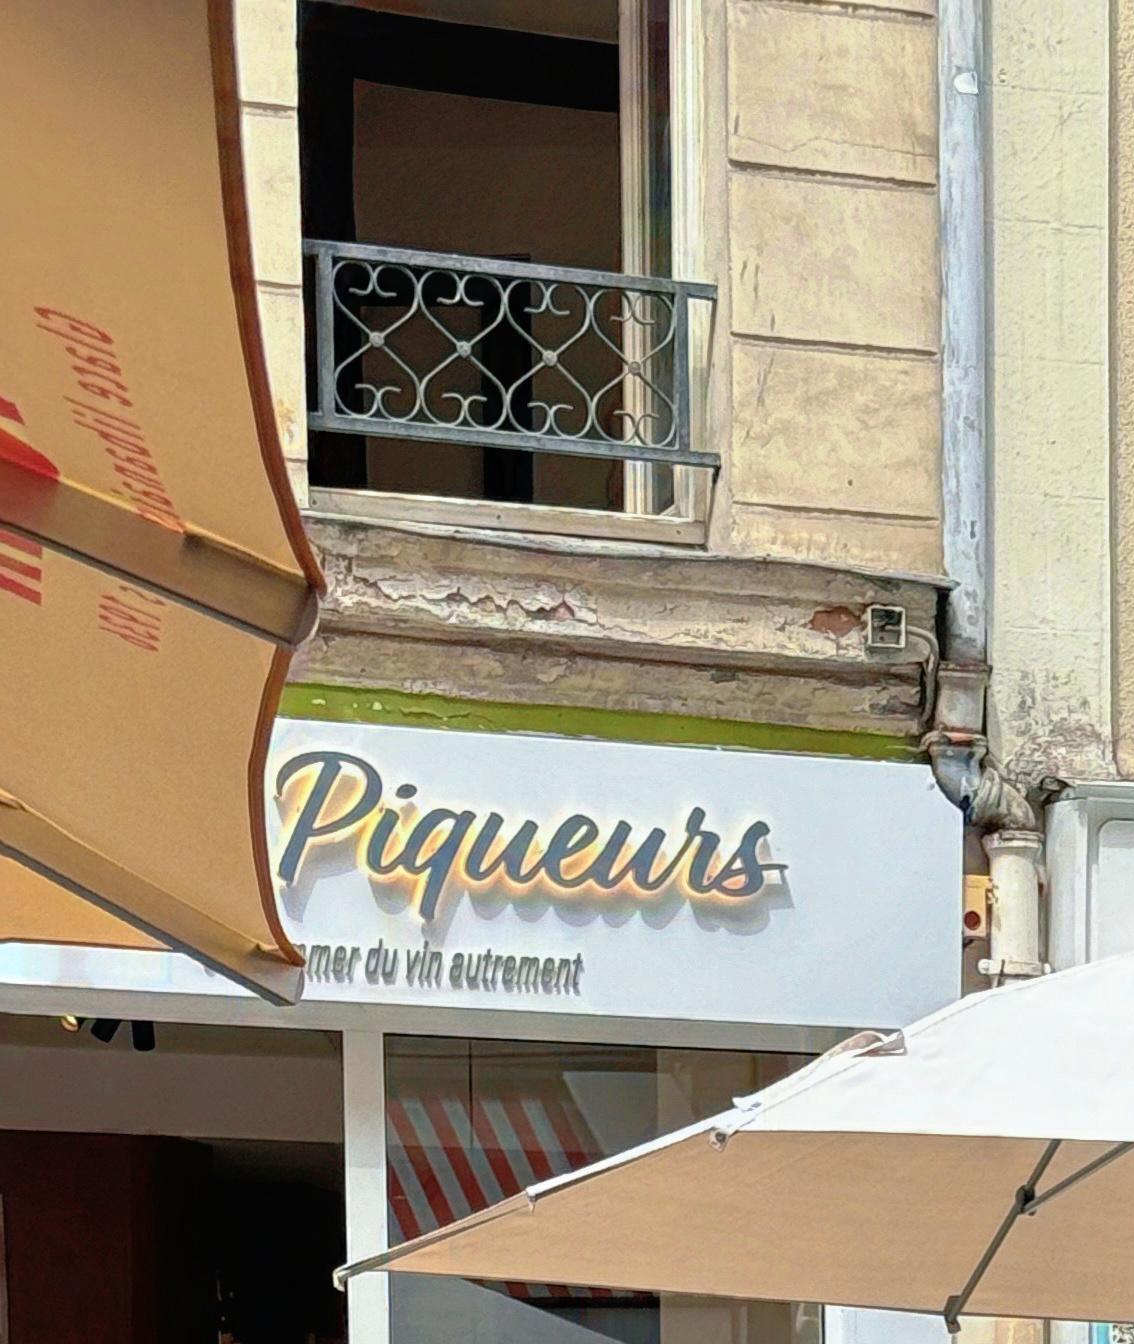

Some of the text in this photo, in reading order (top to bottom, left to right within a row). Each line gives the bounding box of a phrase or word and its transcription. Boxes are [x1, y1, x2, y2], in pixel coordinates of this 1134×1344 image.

[275, 750, 789, 924] Piqueurs
[365, 938, 398, 978] du
[406, 940, 443, 982] vin
[450, 948, 584, 989] autrement
